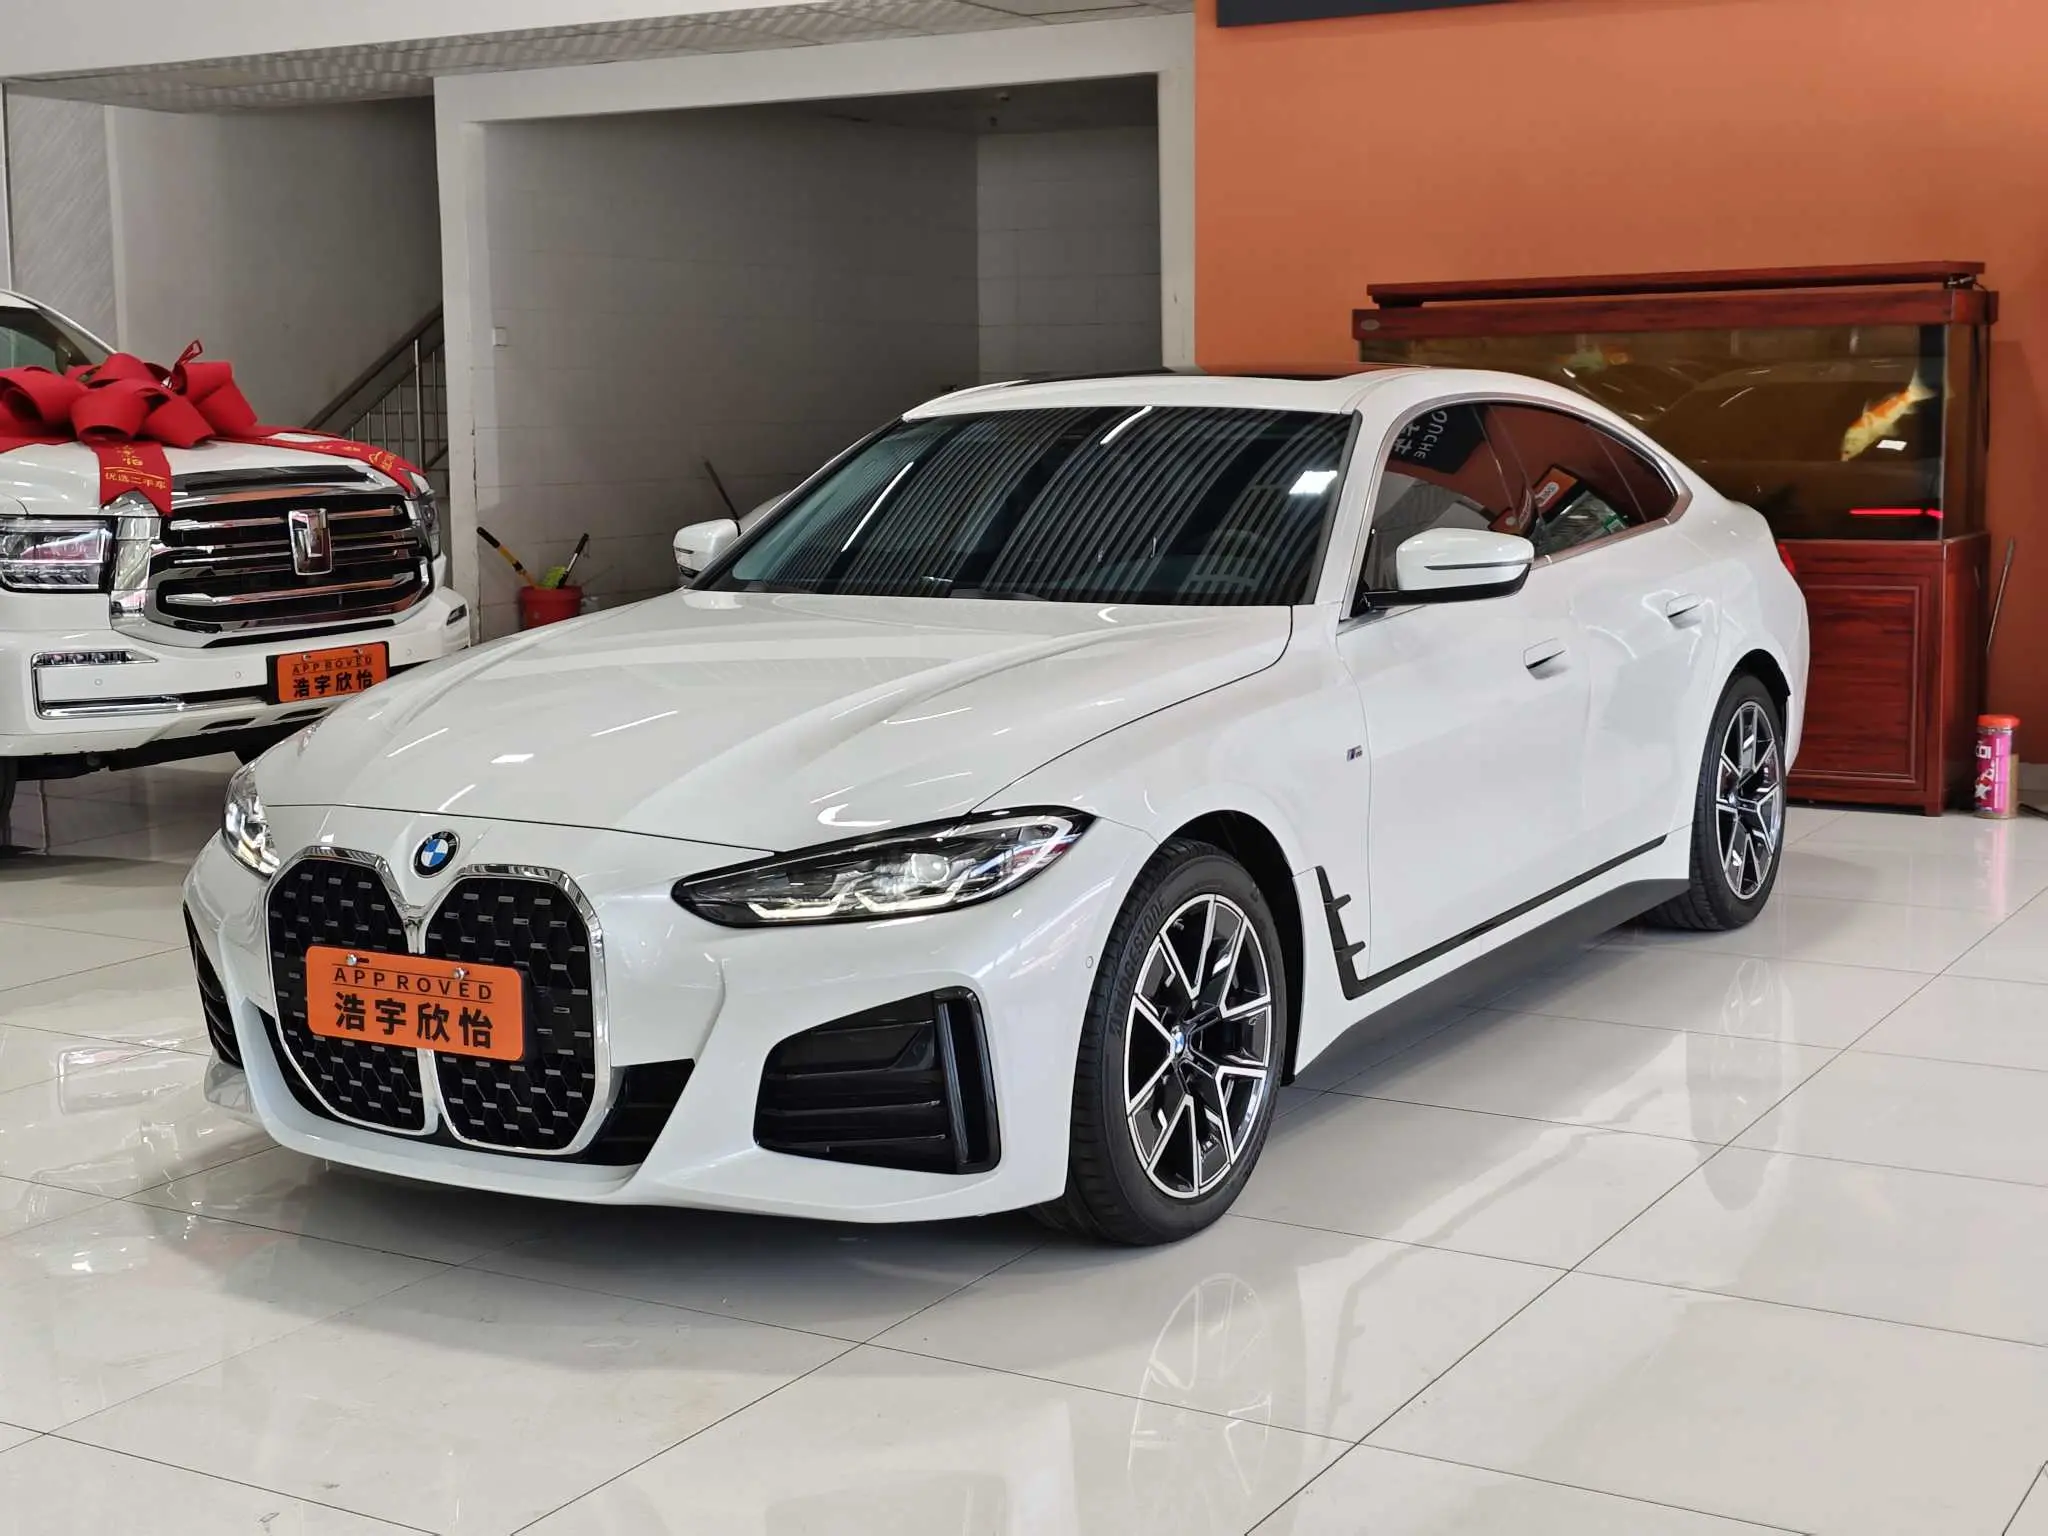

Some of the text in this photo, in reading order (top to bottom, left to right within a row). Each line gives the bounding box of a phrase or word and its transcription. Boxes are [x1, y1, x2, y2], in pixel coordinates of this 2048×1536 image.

[293, 669, 373, 698] 浩宇欣怡
[334, 966, 492, 1000] APPROVED
[334, 991, 494, 1049] 浩宇欣怡
